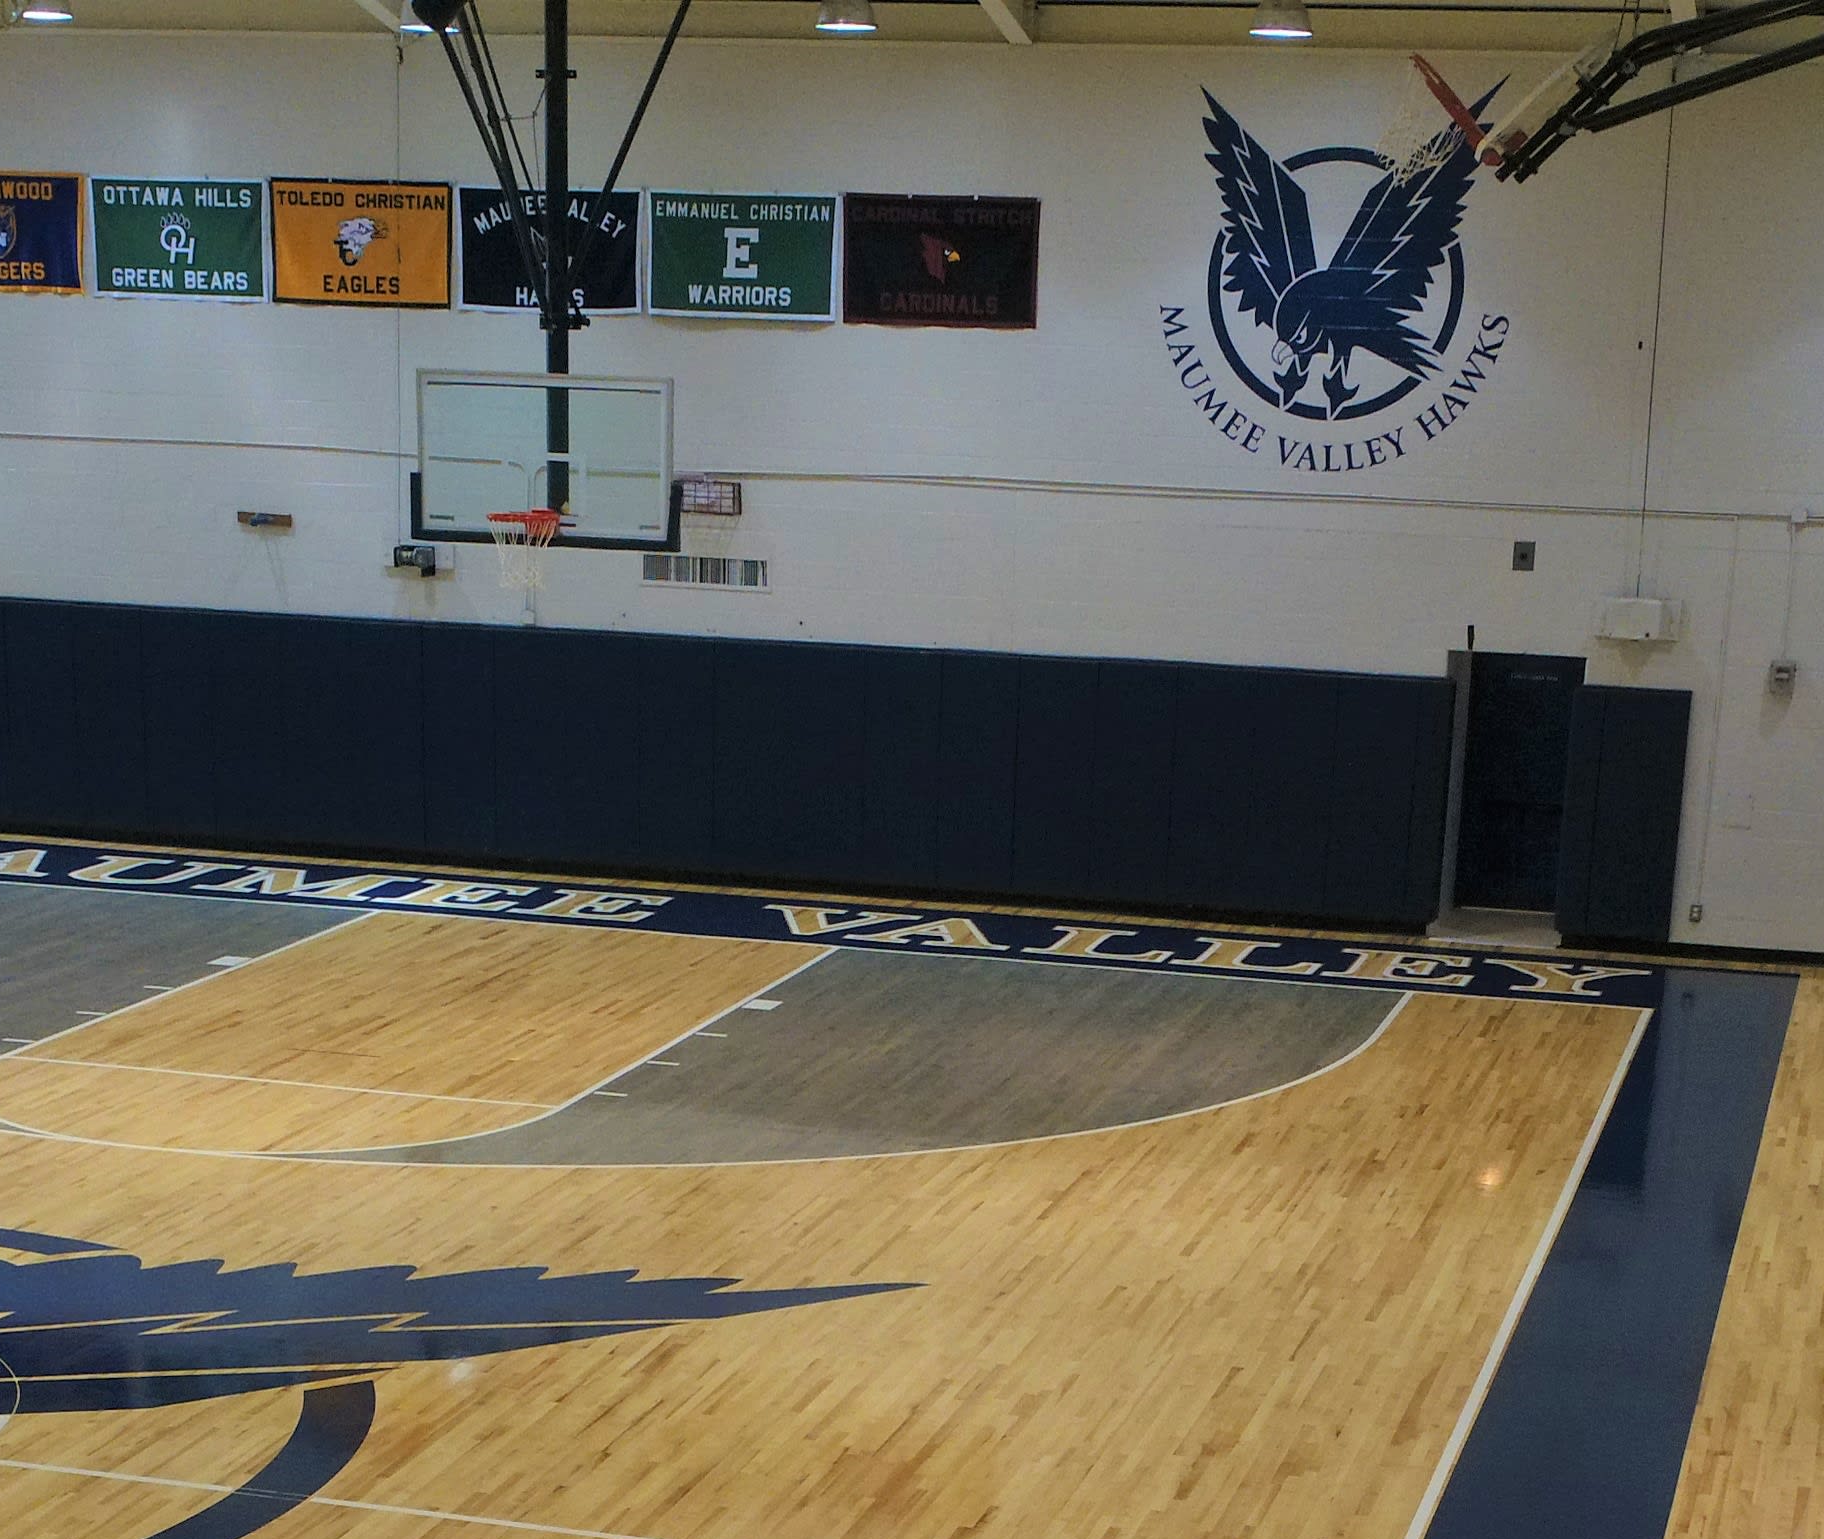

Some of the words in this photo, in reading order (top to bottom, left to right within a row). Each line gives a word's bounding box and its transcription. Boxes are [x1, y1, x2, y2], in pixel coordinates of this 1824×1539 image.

[103, 186, 183, 207] OTTAWA
[195, 187, 251, 208] HILLS
[276, 190, 344, 208] TOLEDO
[355, 193, 445, 210] CHRISTIAN
[473, 195, 547, 235] MAUEE
[656, 200, 739, 219] EMMANUEL
[750, 204, 830, 222] CHRISTIAN
[723, 227, 759, 279] E
[111, 268, 174, 288] GREEN
[184, 270, 249, 290] BEARS
[323, 275, 400, 295] EAGLES
[688, 284, 791, 307] WARRIORS
[879, 291, 998, 315] CARDINALS
[1159, 304, 1267, 454] MAUMEE
[1277, 425, 1407, 472] VALLEY
[1413, 313, 1510, 442] HAWKS
[764, 904, 1655, 997] VALLEY
